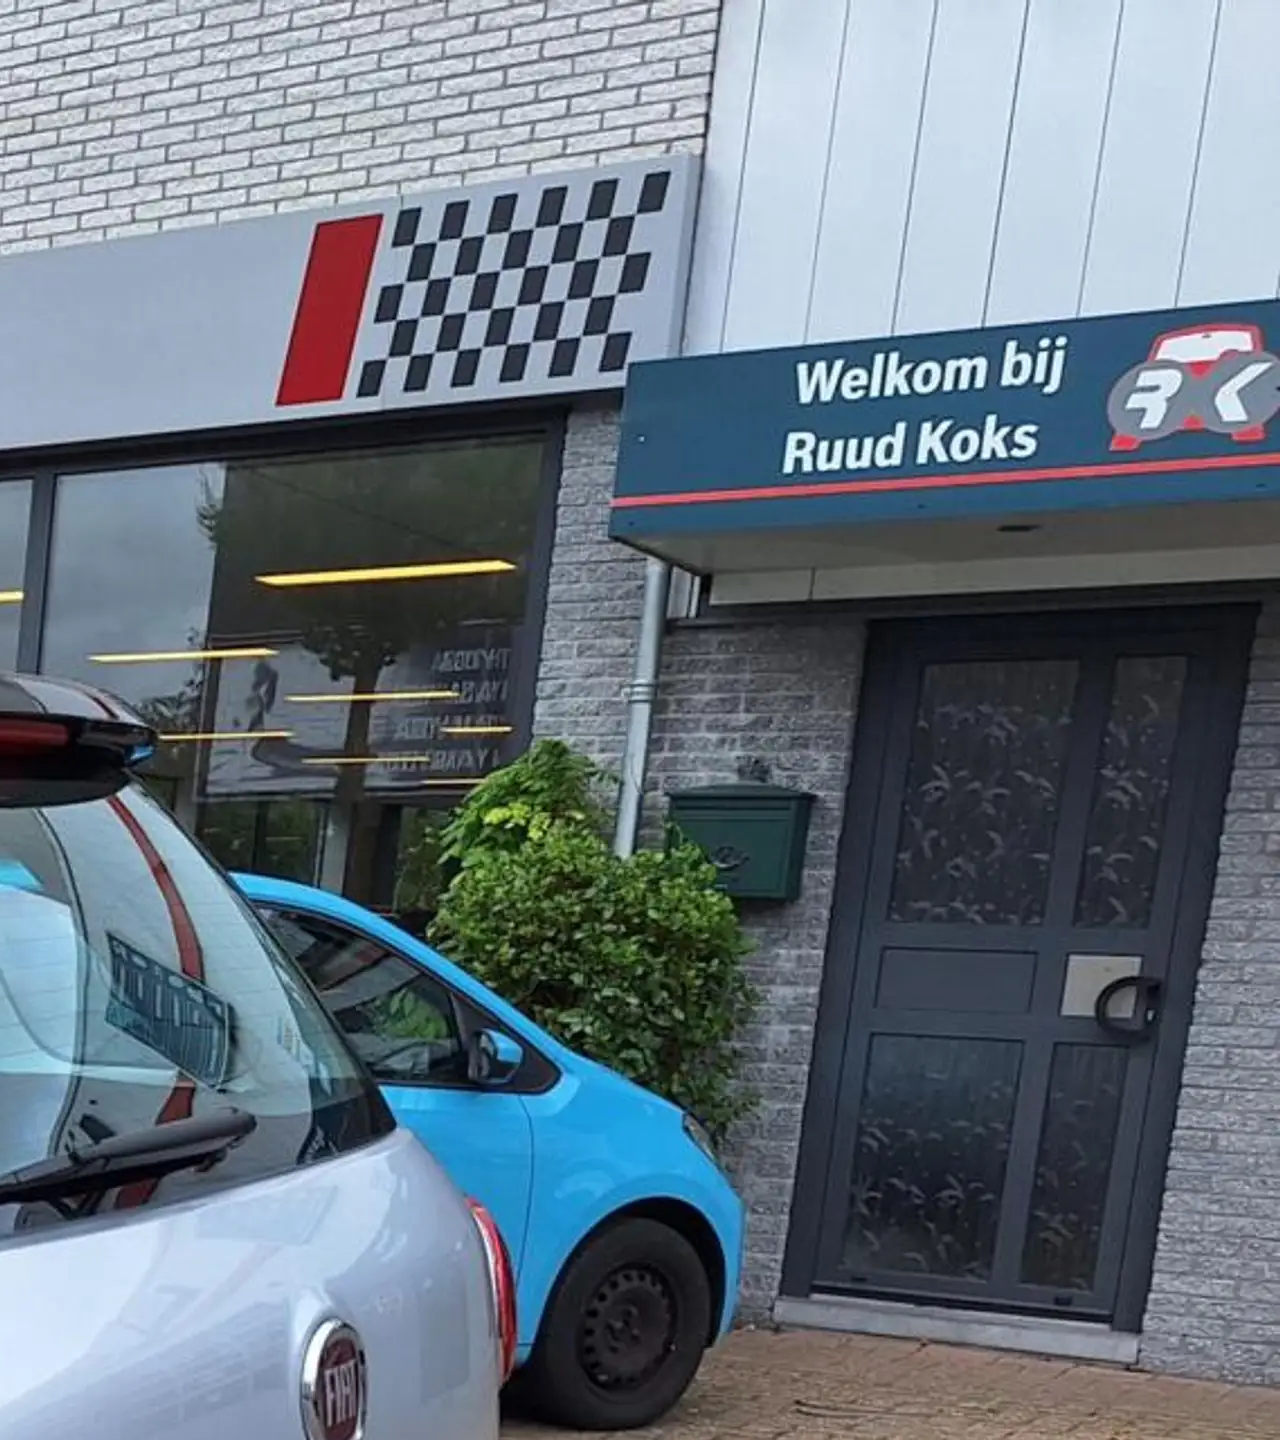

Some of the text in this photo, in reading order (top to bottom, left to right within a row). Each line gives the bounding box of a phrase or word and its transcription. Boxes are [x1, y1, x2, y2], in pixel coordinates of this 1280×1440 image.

[795, 336, 1069, 405] Welkom bij
[782, 413, 1040, 475] Ruud Koks
